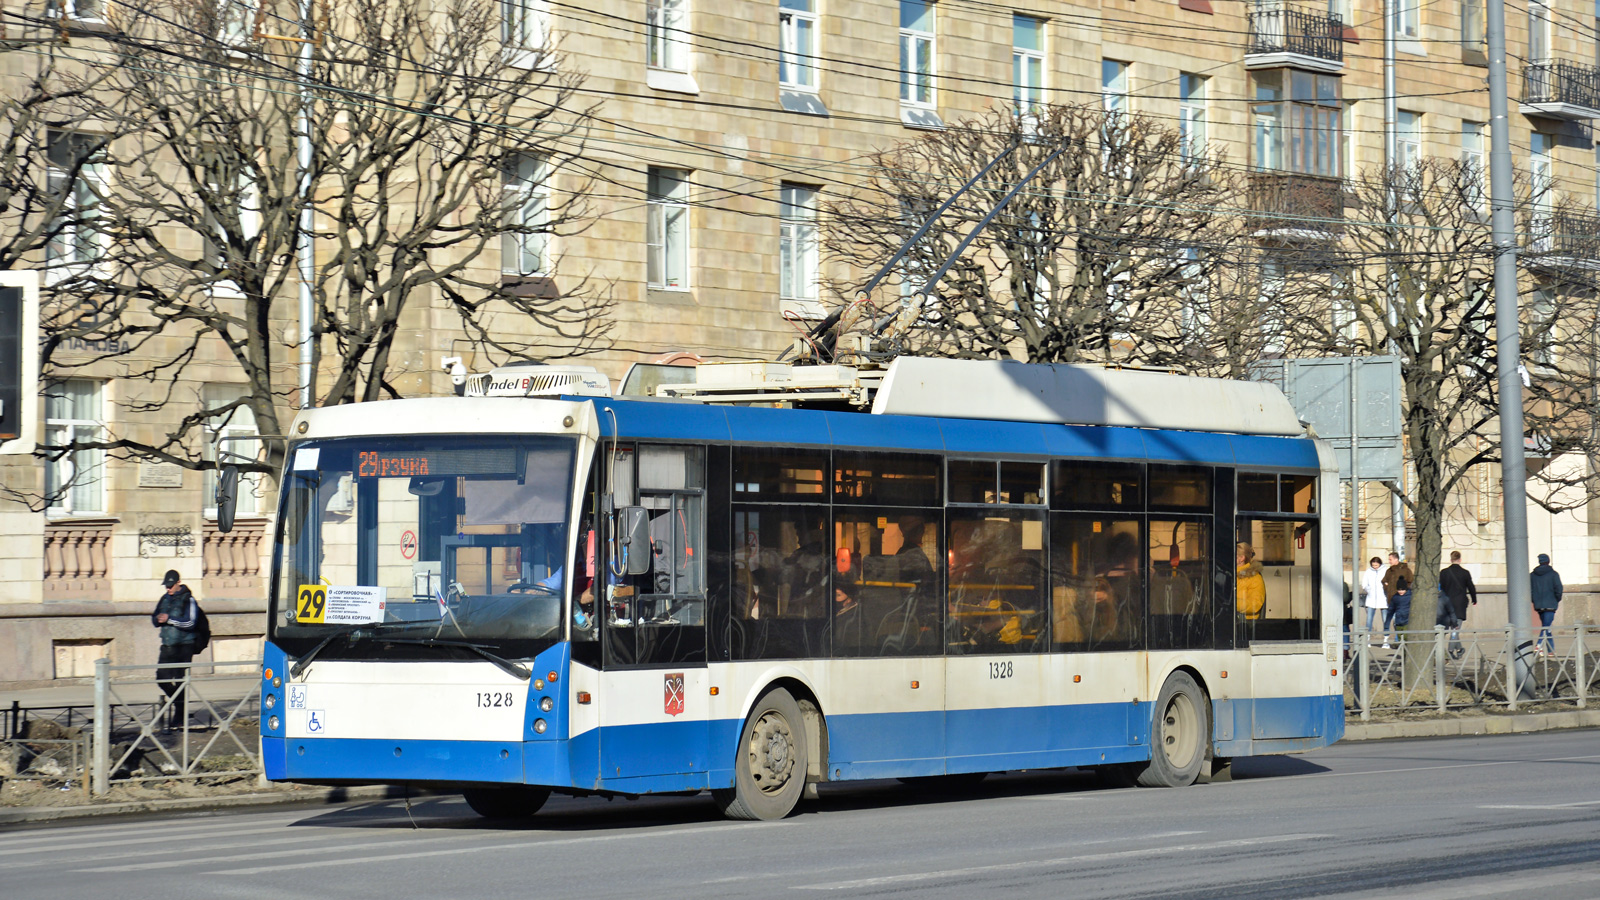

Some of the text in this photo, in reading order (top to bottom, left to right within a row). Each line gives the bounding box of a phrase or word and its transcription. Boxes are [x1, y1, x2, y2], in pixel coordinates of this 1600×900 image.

[488, 378, 520, 390] ndel
[359, 451, 429, 477] 29 РЗУНА
[298, 589, 326, 618] 29
[989, 660, 1013, 680] 1328
[476, 692, 513, 708] 1328
